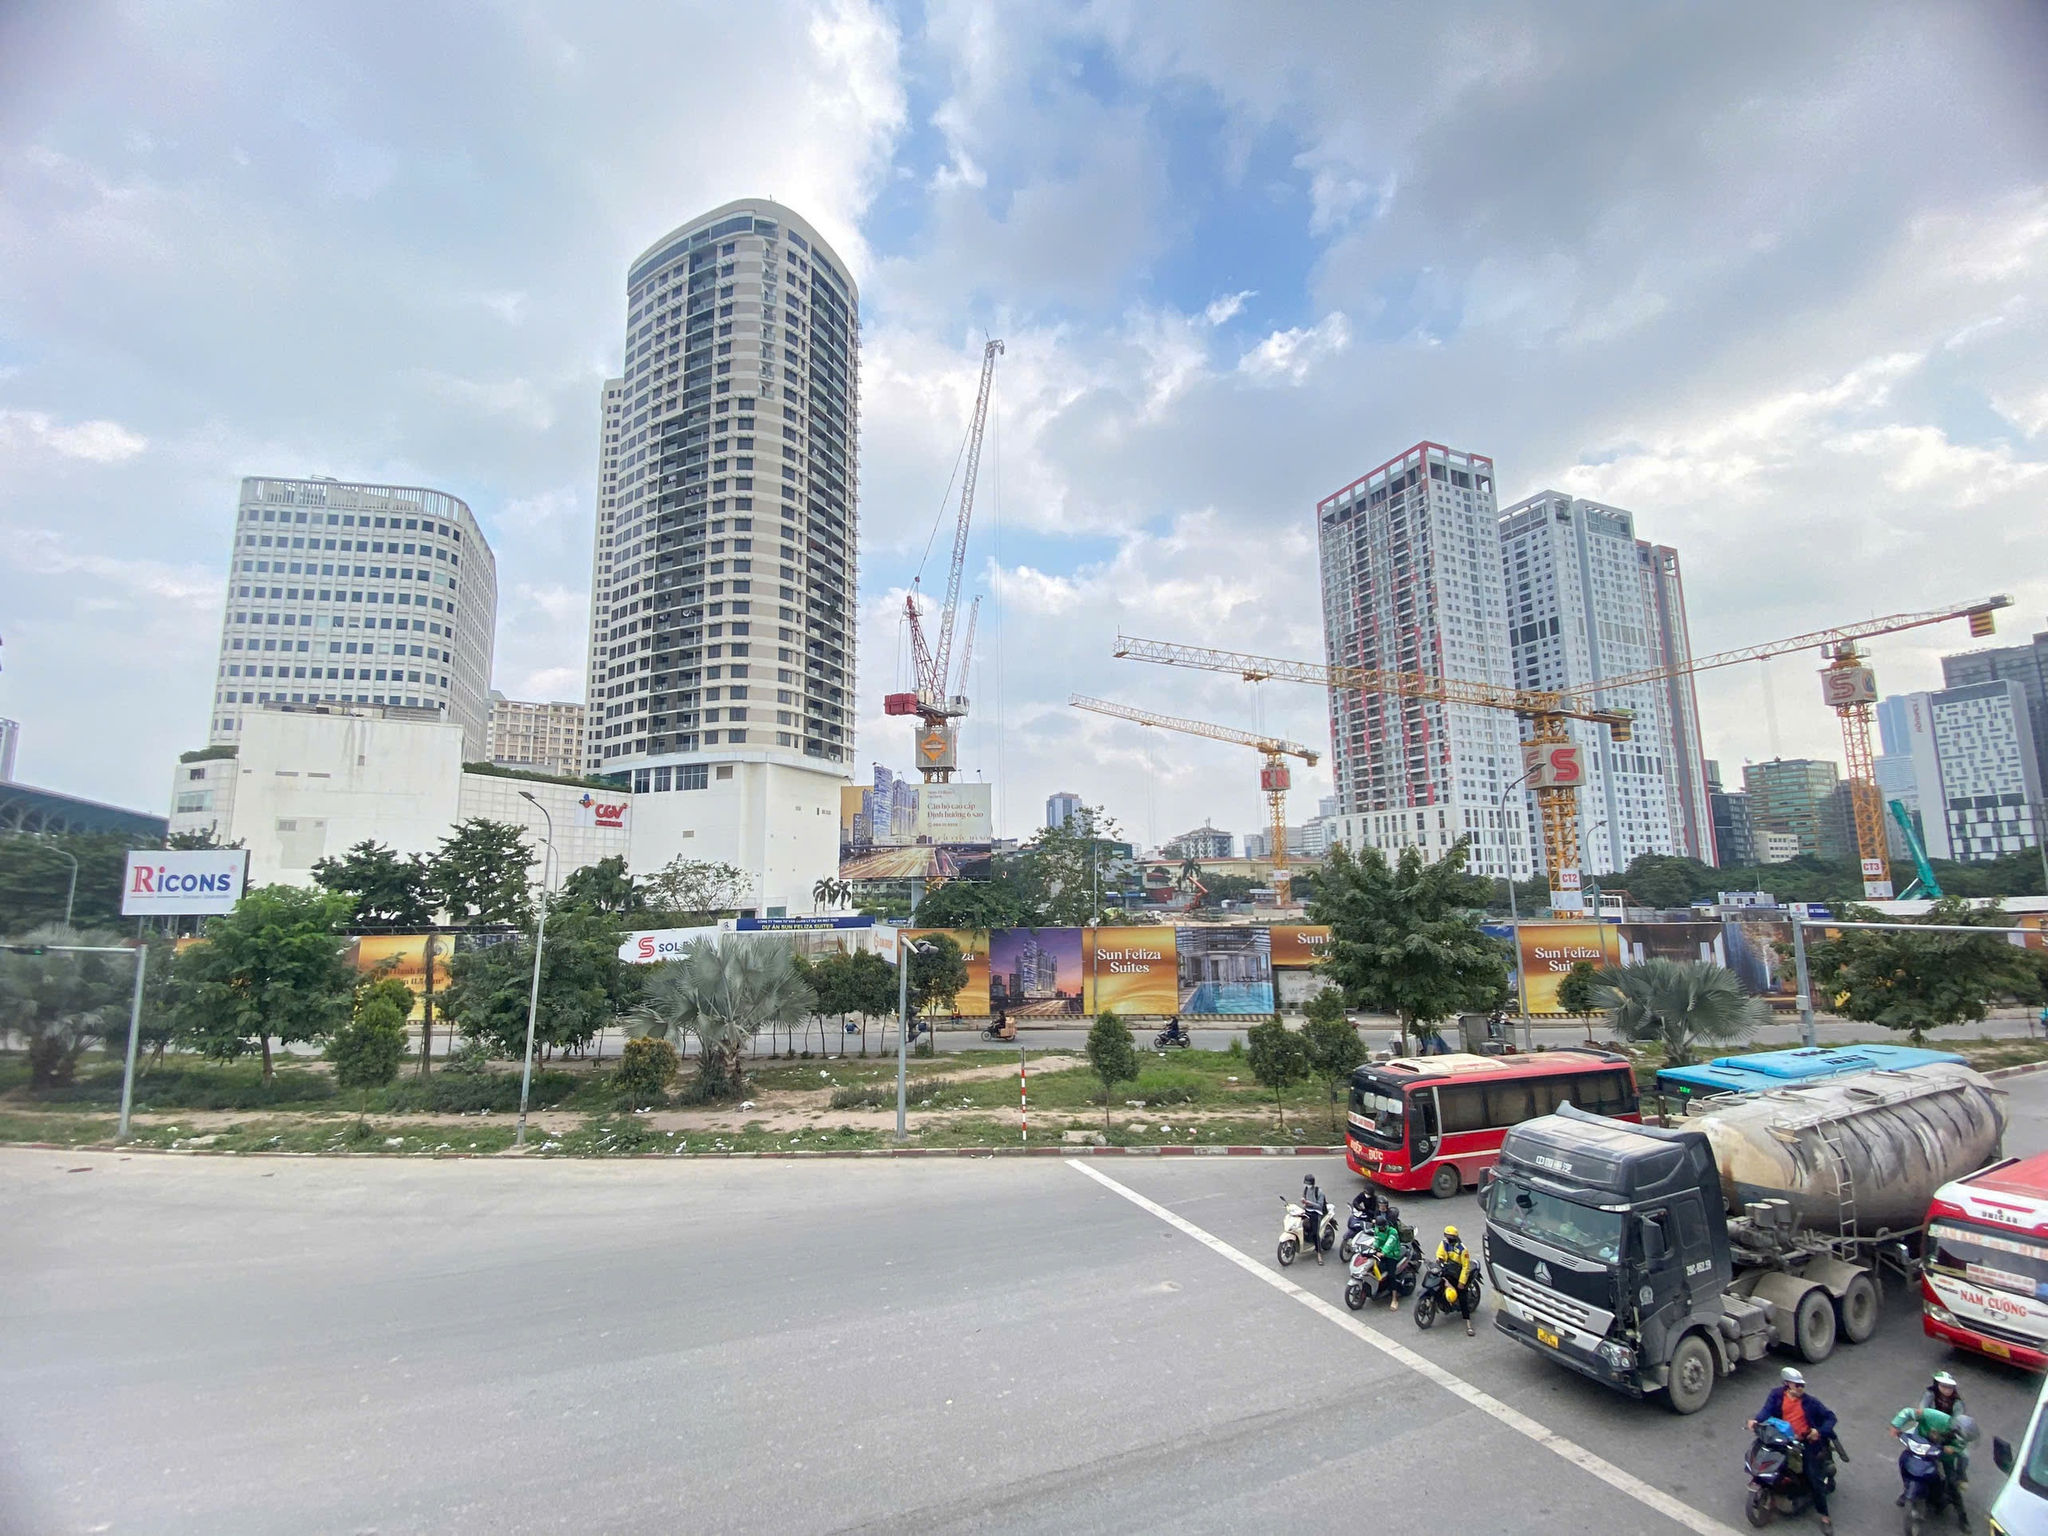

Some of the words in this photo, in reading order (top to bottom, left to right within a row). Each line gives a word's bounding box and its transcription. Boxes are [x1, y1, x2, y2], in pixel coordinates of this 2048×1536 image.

[595, 803, 628, 819] CGV
[1863, 863, 1880, 871] CT3
[1562, 873, 1578, 883] CT2
[1297, 932, 1323, 944] Sun
[1097, 948, 1122, 960] Sun
[1125, 948, 1161, 960] Feliza
[1535, 947, 1560, 959] Sun
[1563, 946, 1600, 958] Feliza
[1110, 961, 1150, 973] Suites
[1960, 1289, 1984, 1306] NAM
